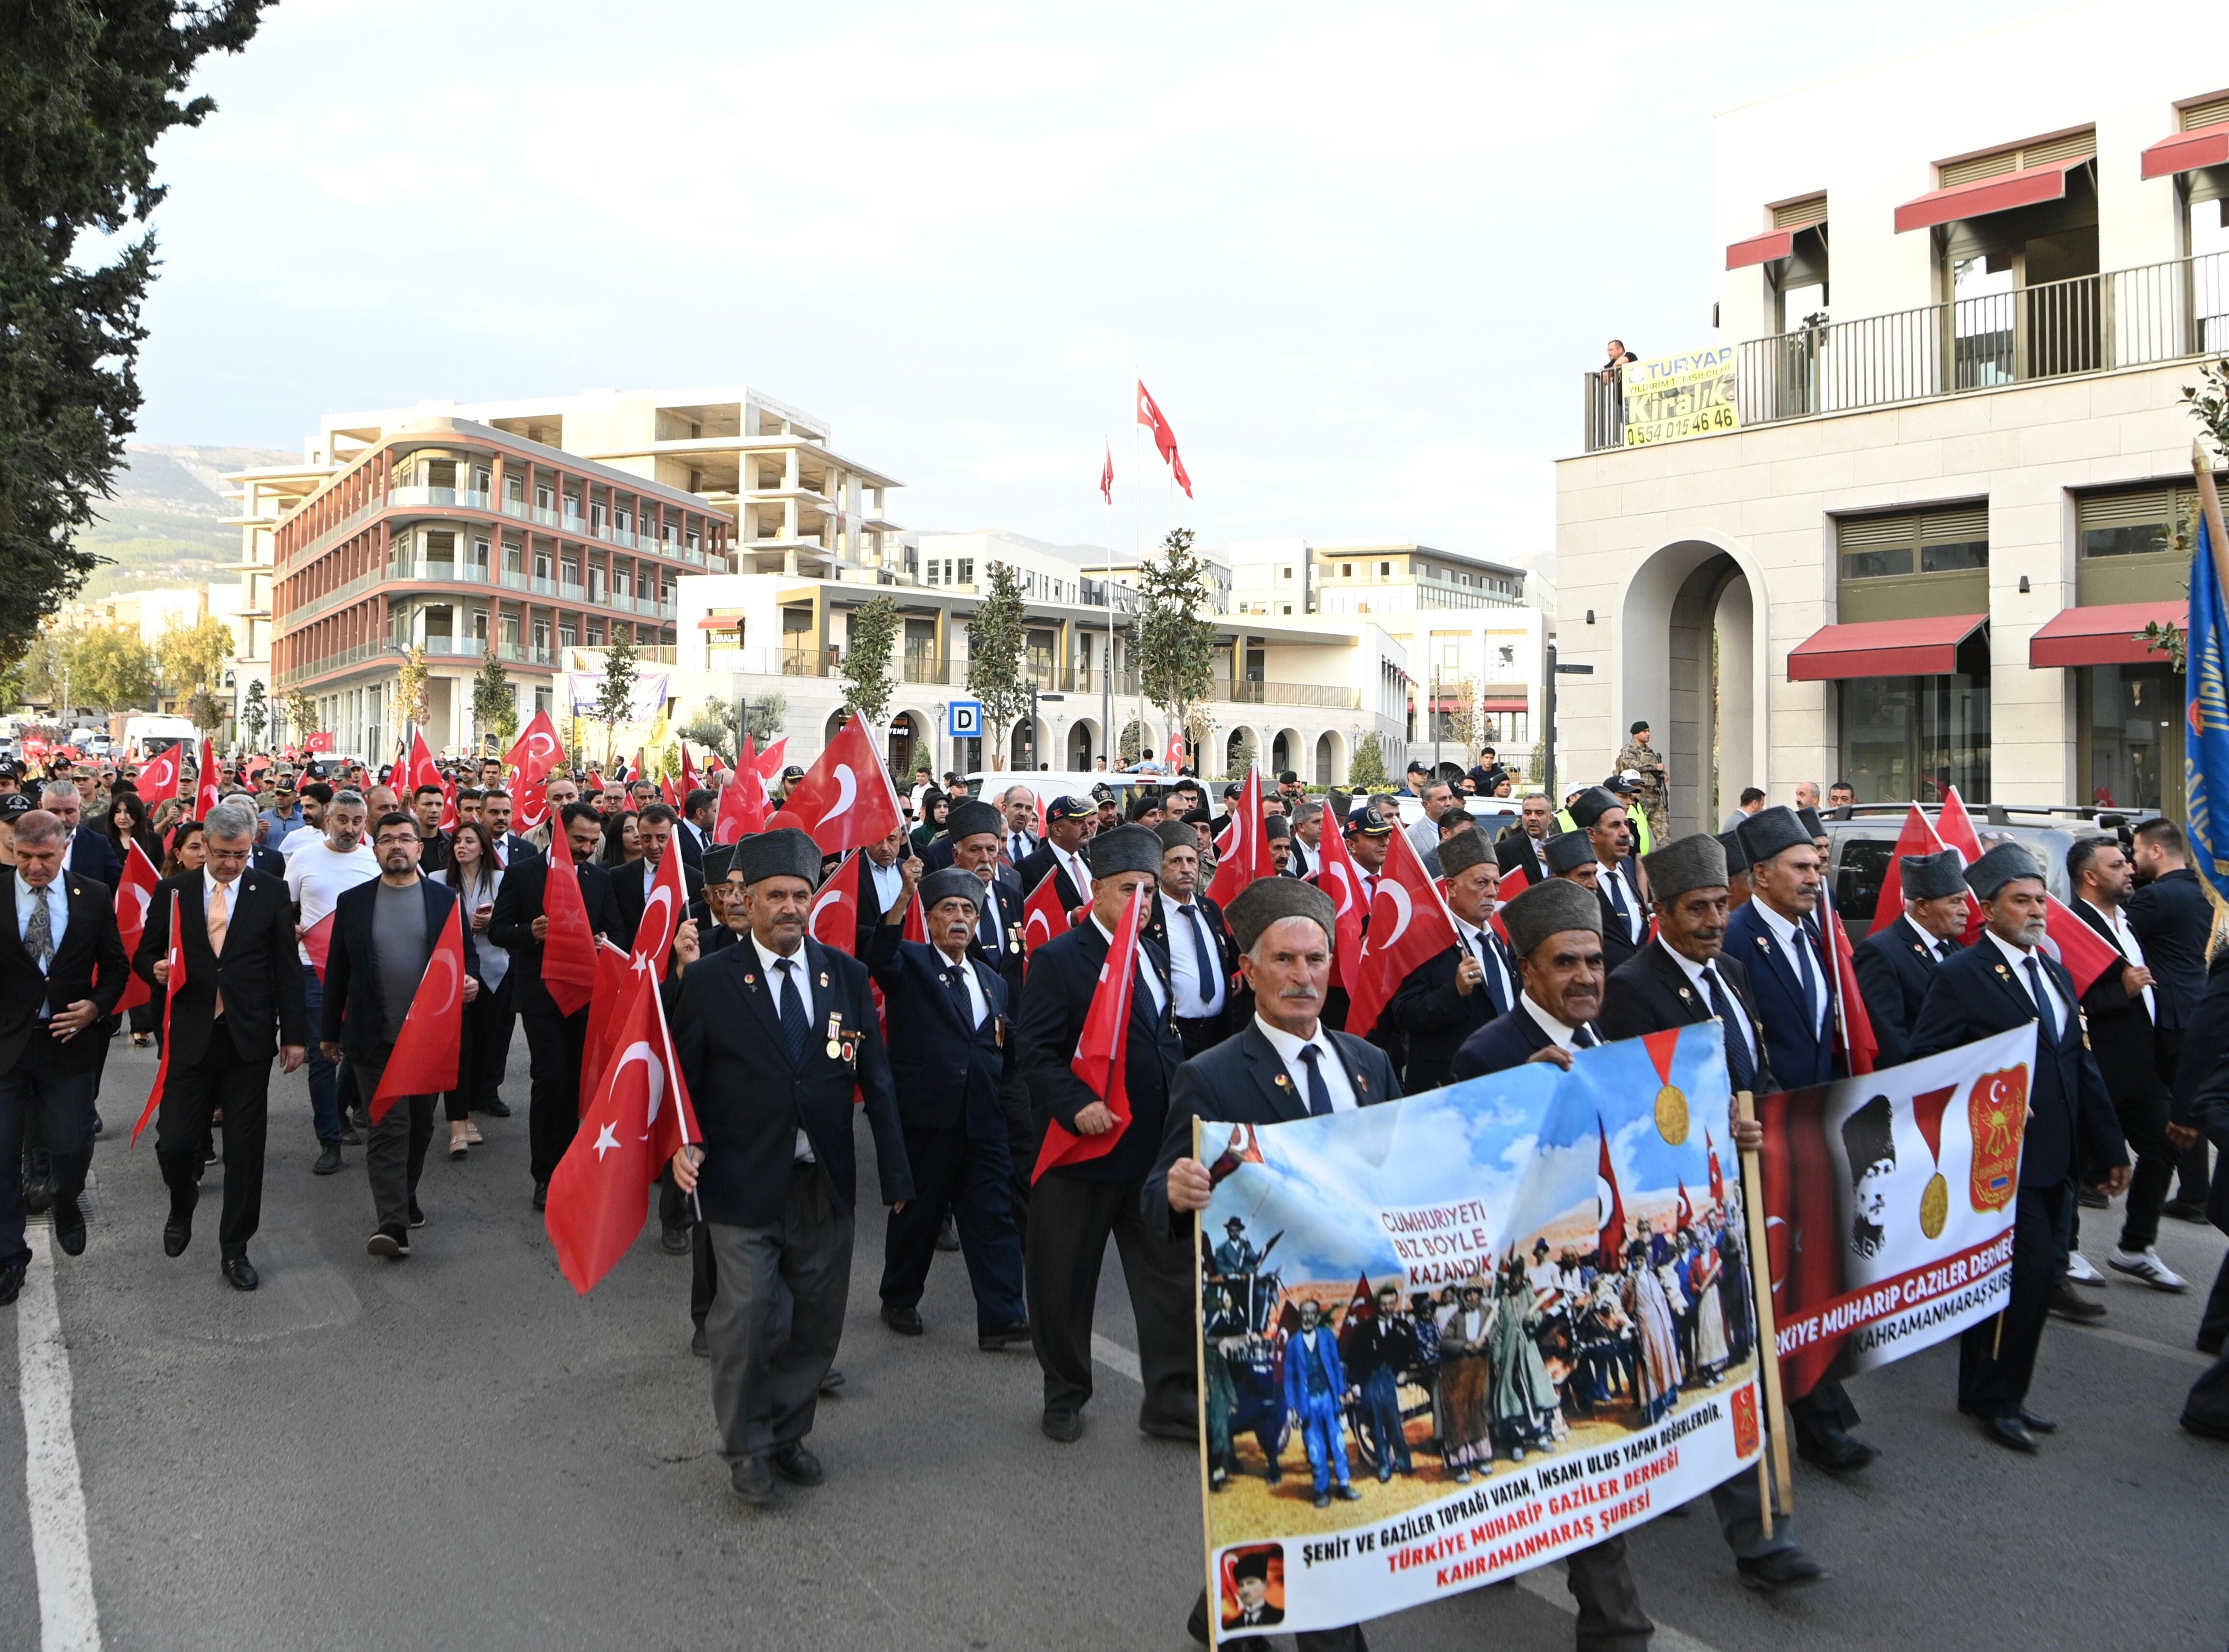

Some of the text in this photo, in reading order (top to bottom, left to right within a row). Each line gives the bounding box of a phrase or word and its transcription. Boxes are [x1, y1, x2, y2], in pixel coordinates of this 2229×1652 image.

[1647, 347, 1732, 380] TURYAP
[1628, 409, 1733, 445] 0 554 015 46 46
[958, 710, 972, 728] D
[1410, 1253, 1492, 1286] KAZANDIK
[1821, 1285, 1901, 1337] MUHARİP
[1903, 1259, 1968, 1303] GAZİLER
[1970, 1228, 2015, 1278] DERNEĞ
[1855, 1283, 1986, 1353] KAHRAMANMARAŞ
[1303, 1401, 1723, 1569] ŞEHİT VE GAZİLER TOPRAĞI VATAN, İNSANI ULUS YAPAN DEĞERLERDİR.
[1387, 1446, 1680, 1575] TÜRKİYE MUHARİP GAZİLER DERNEĞİ
[1436, 1488, 1651, 1588] KAHRAMANMARAŞ ŞUBESİ
